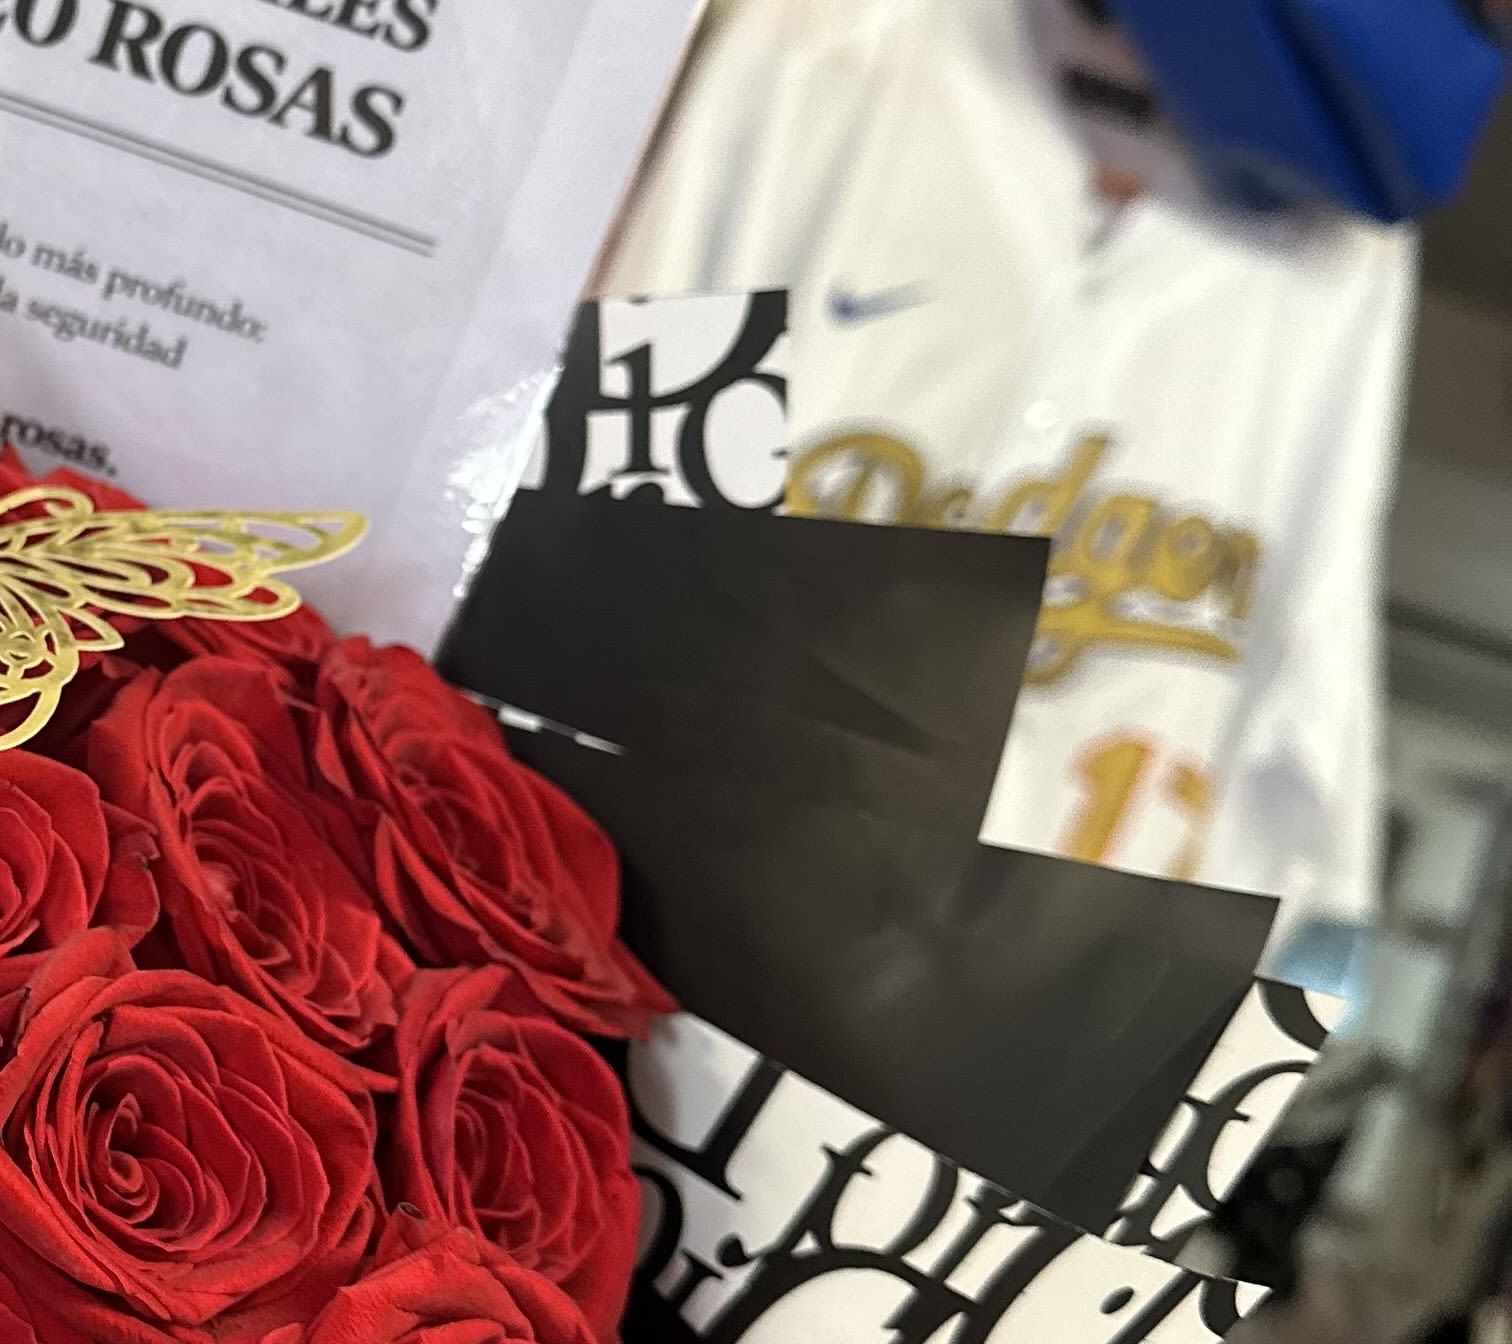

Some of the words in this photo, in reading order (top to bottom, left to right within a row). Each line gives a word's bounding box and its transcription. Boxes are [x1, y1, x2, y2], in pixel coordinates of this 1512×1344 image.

[31, 236, 101, 286] más
[24, 292, 186, 370] seguridad
[0, 412, 117, 477] rosas.
